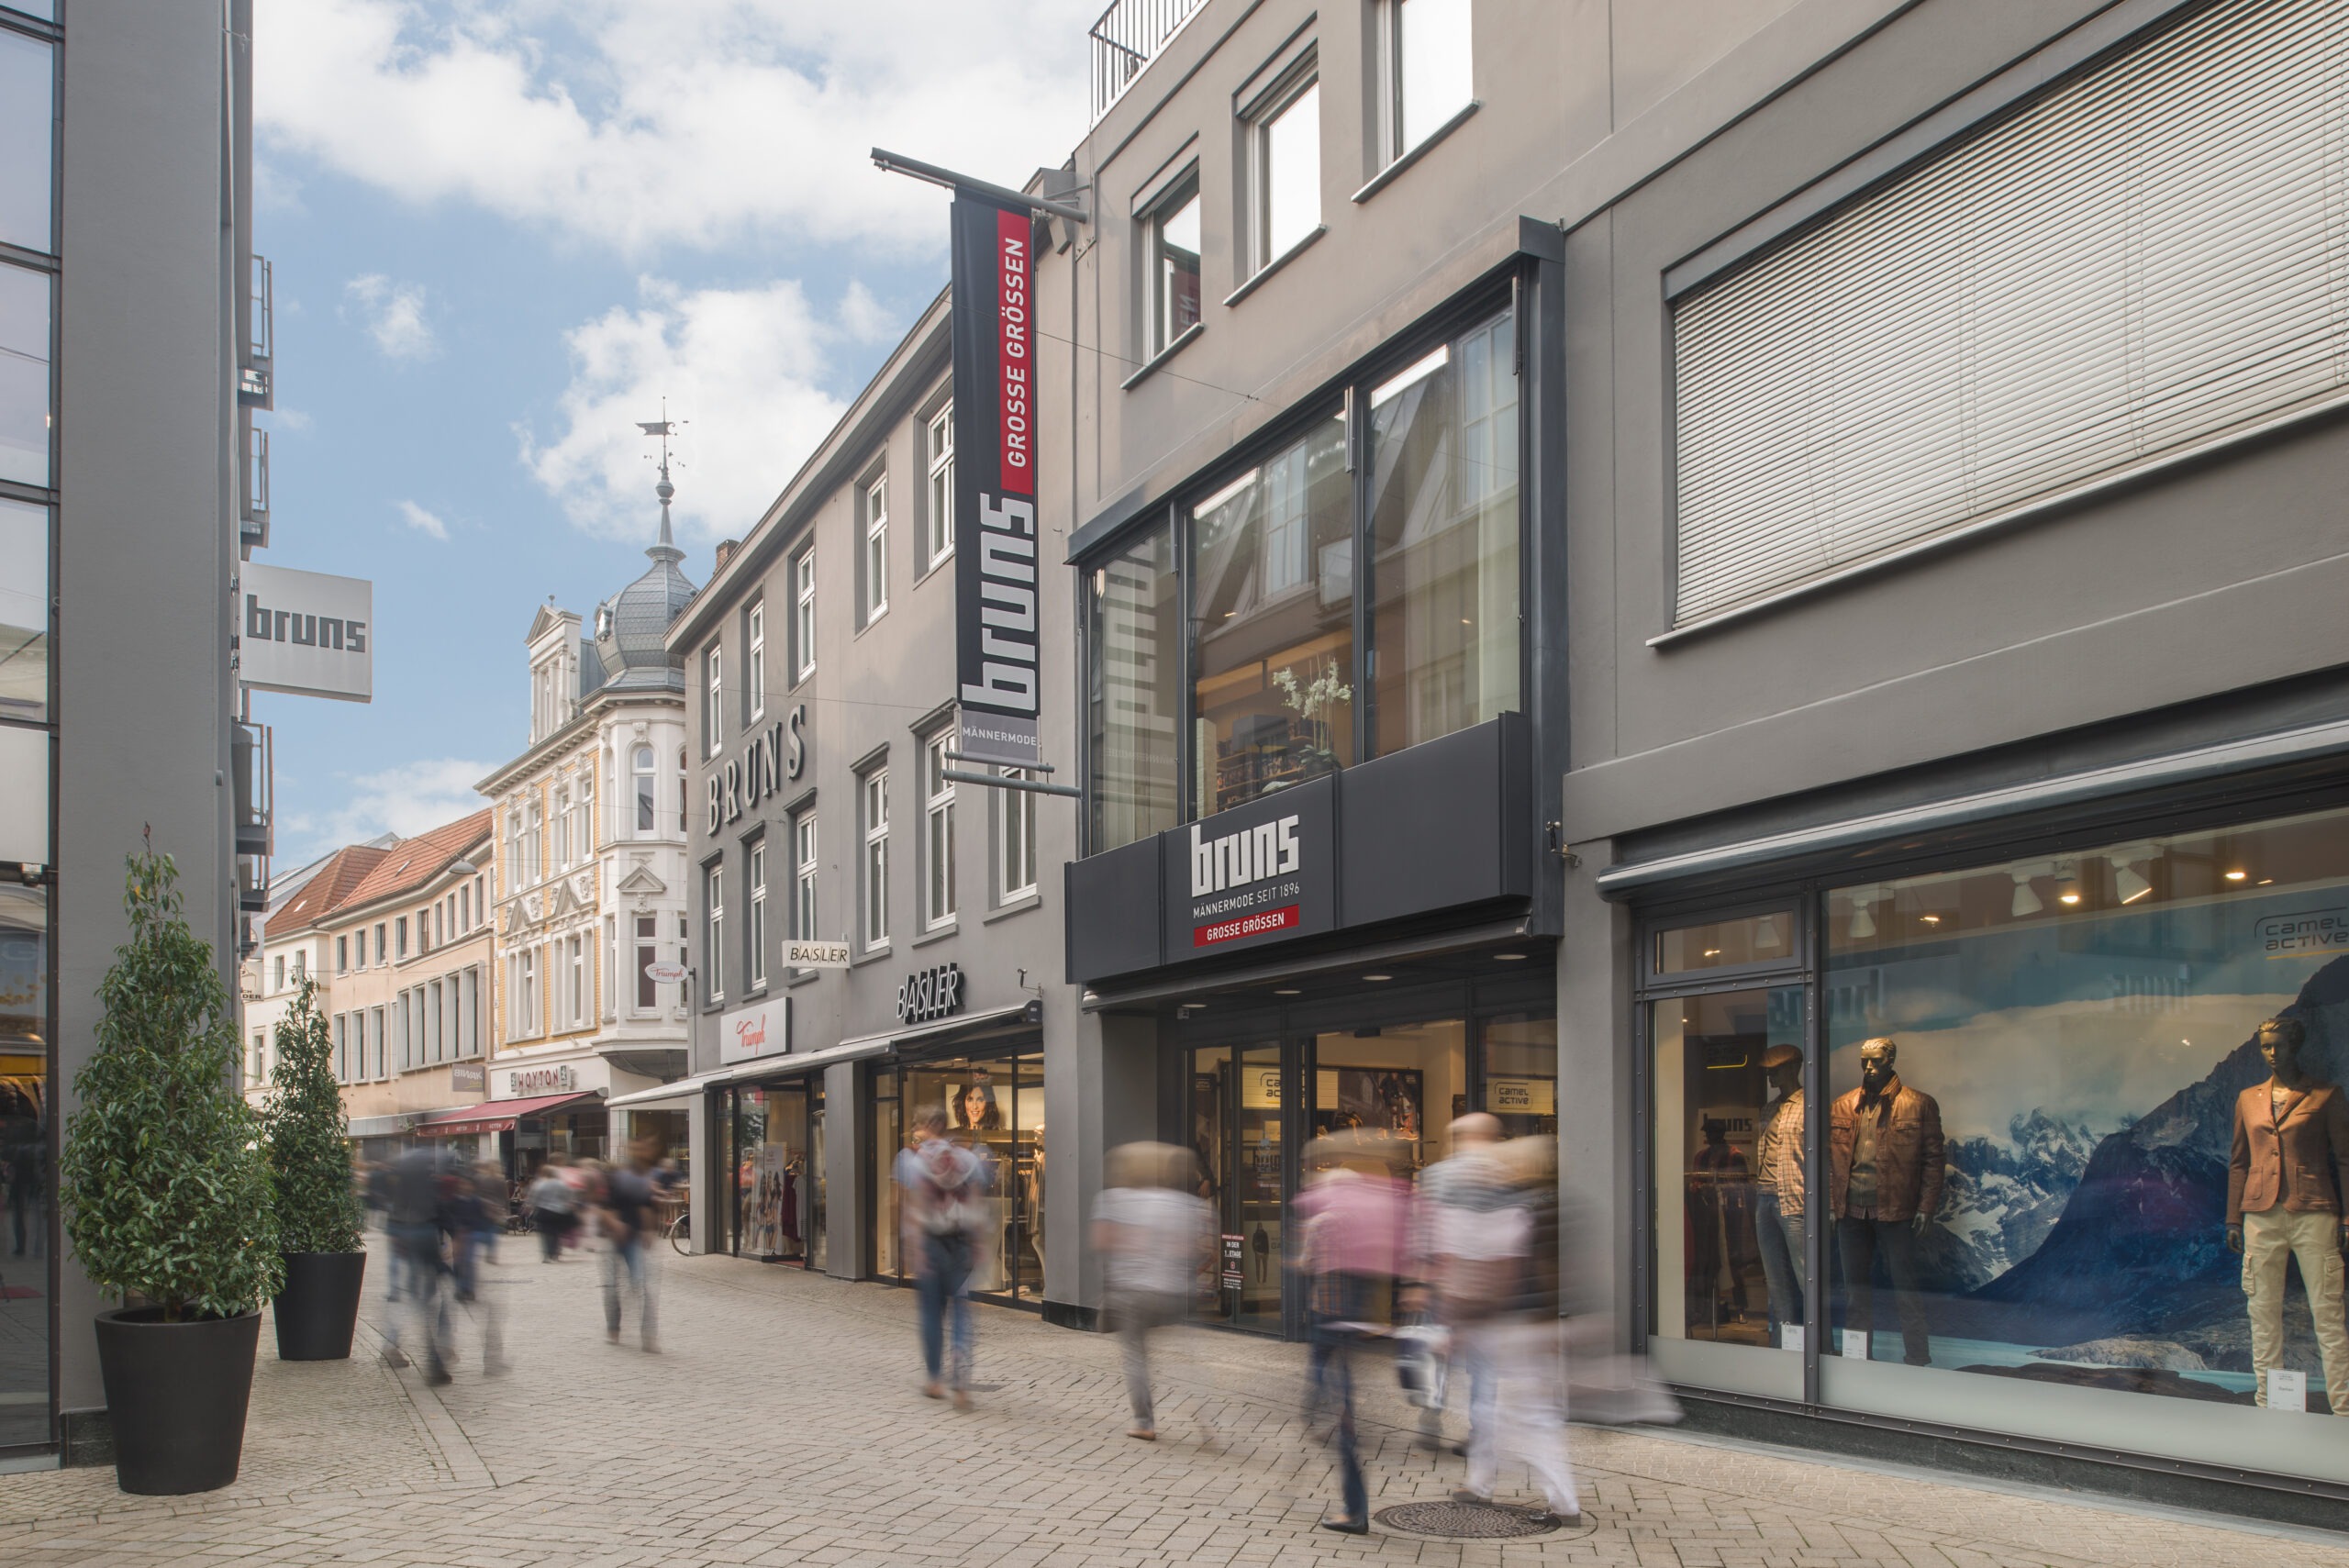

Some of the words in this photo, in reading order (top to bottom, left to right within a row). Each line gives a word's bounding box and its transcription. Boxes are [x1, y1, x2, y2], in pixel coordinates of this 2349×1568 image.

[1001, 238, 1025, 359] GRÖSSEN
[1006, 365, 1027, 468] GROSSE
[246, 593, 366, 653] bruns
[961, 492, 1036, 712] bruns
[962, 725, 1037, 747] MÄNNERMODE
[706, 704, 807, 838] BRUNS
[1191, 814, 1299, 898] bruns
[1193, 893, 1254, 919] MÄNNERMODE
[1257, 886, 1277, 904] SEIT
[1280, 881, 1300, 897] 1896
[1207, 922, 1241, 941] GROSSE
[1242, 912, 1285, 934] GRÖSSEN
[651, 966, 685, 981] Triumph
[736, 1013, 767, 1056] Triumph
